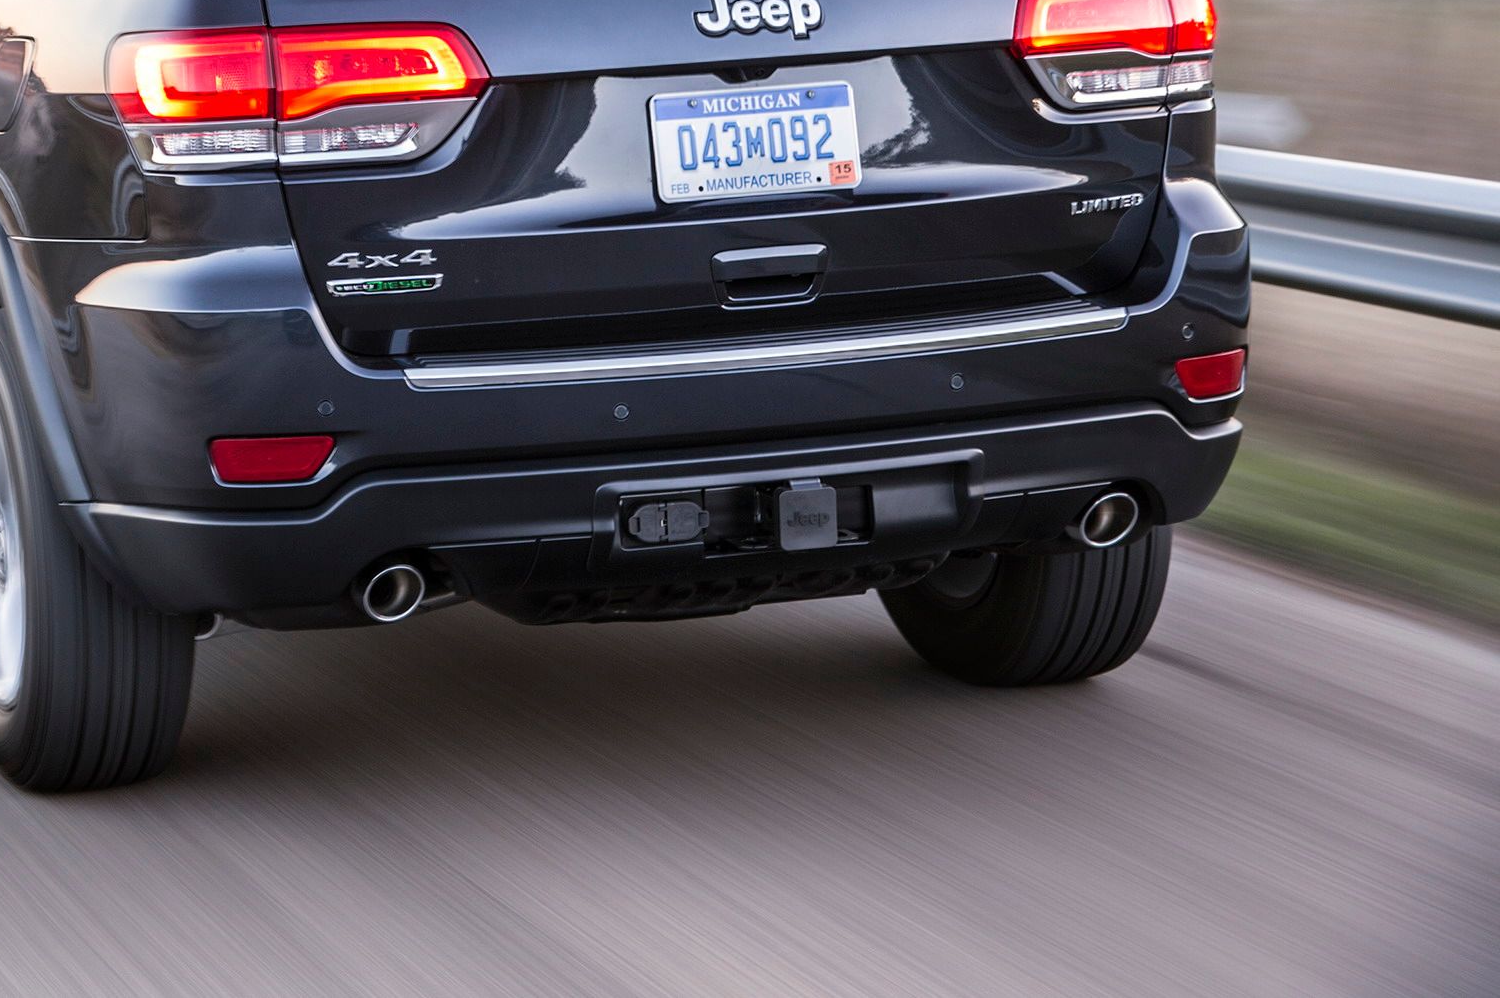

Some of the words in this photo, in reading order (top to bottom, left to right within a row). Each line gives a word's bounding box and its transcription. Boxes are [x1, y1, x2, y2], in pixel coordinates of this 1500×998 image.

[702, 92, 801, 115] MICHIGAN
[677, 114, 835, 171] 043M092
[835, 163, 852, 174] 15
[671, 183, 690, 195] FEB
[706, 171, 813, 192] MANUFACTURER
[1071, 193, 1144, 216] LIMITED
[787, 510, 830, 528] Jeep
